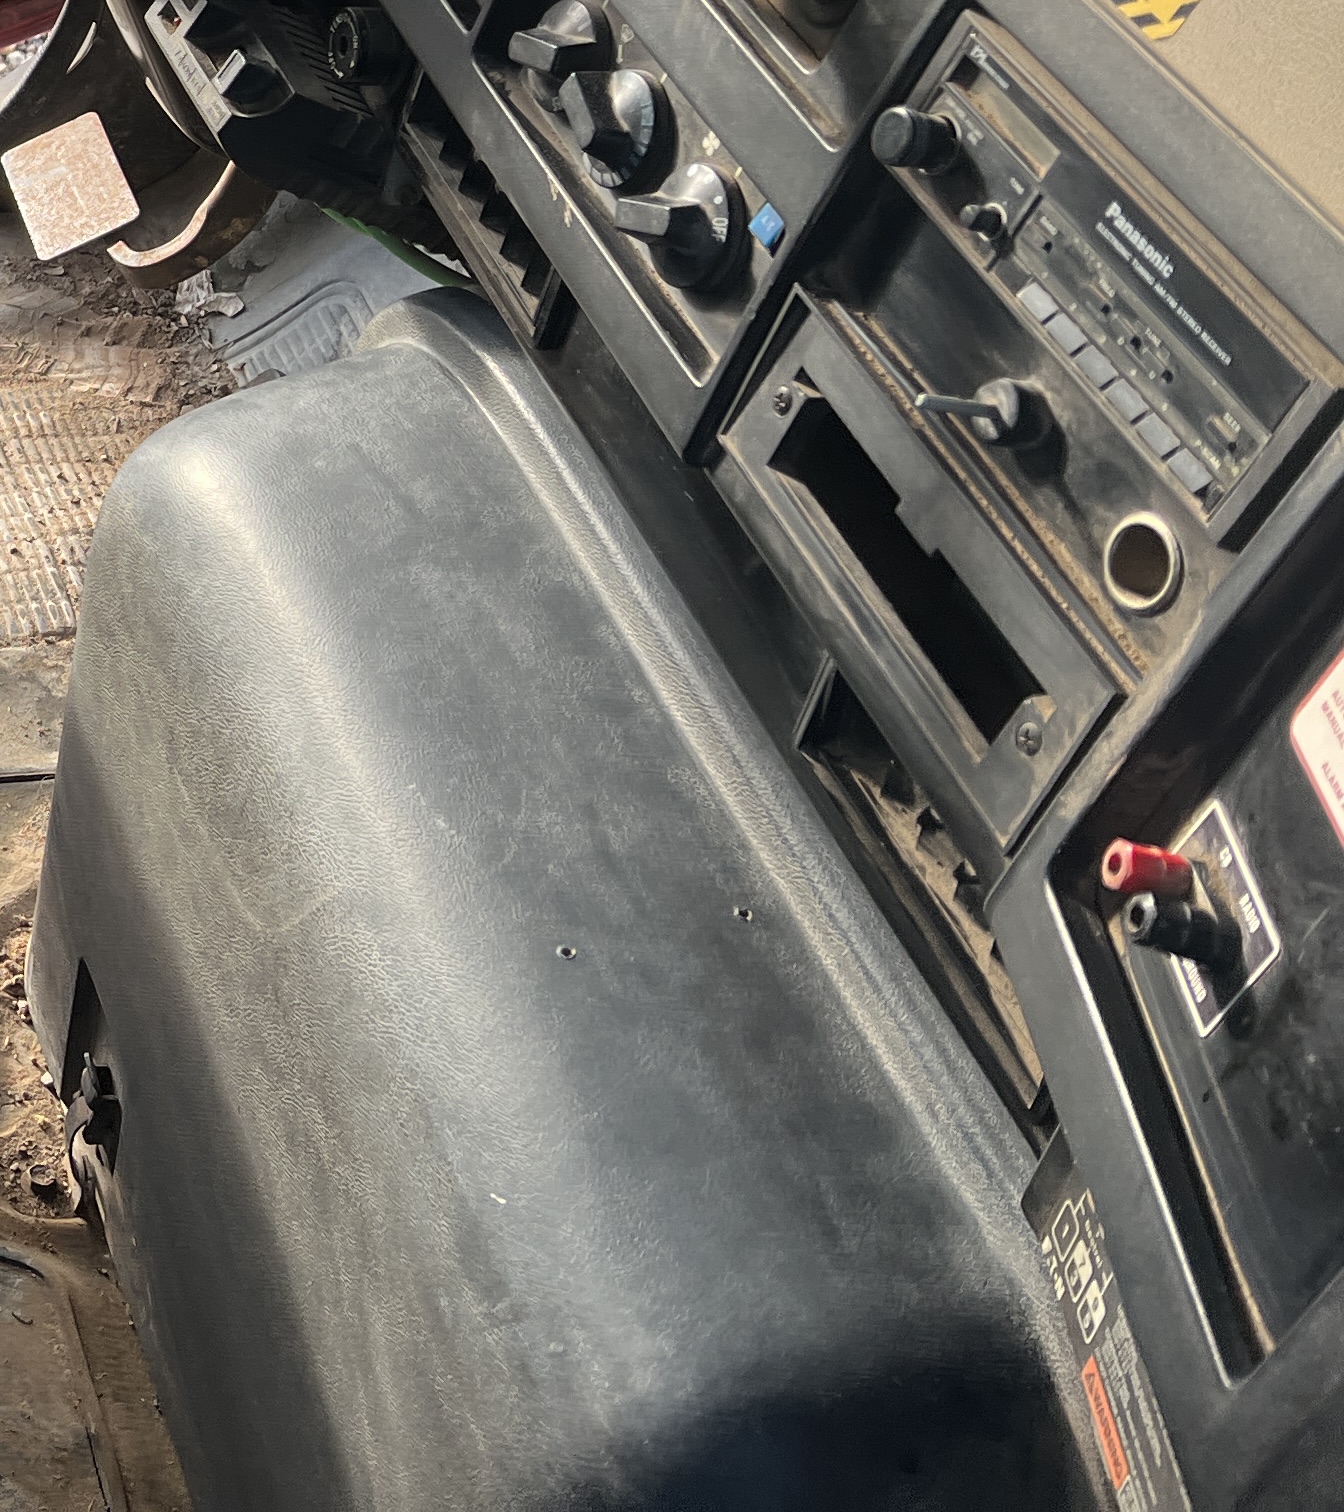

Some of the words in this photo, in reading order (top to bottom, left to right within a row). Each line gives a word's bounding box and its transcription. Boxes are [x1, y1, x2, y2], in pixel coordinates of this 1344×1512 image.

[711, 216, 729, 243] OFF
[1105, 200, 1175, 279] Panasonic
[1200, 331, 1232, 366] RECEIVER
[1238, 893, 1261, 934] RADIO
[1182, 956, 1207, 1004] ROUND
